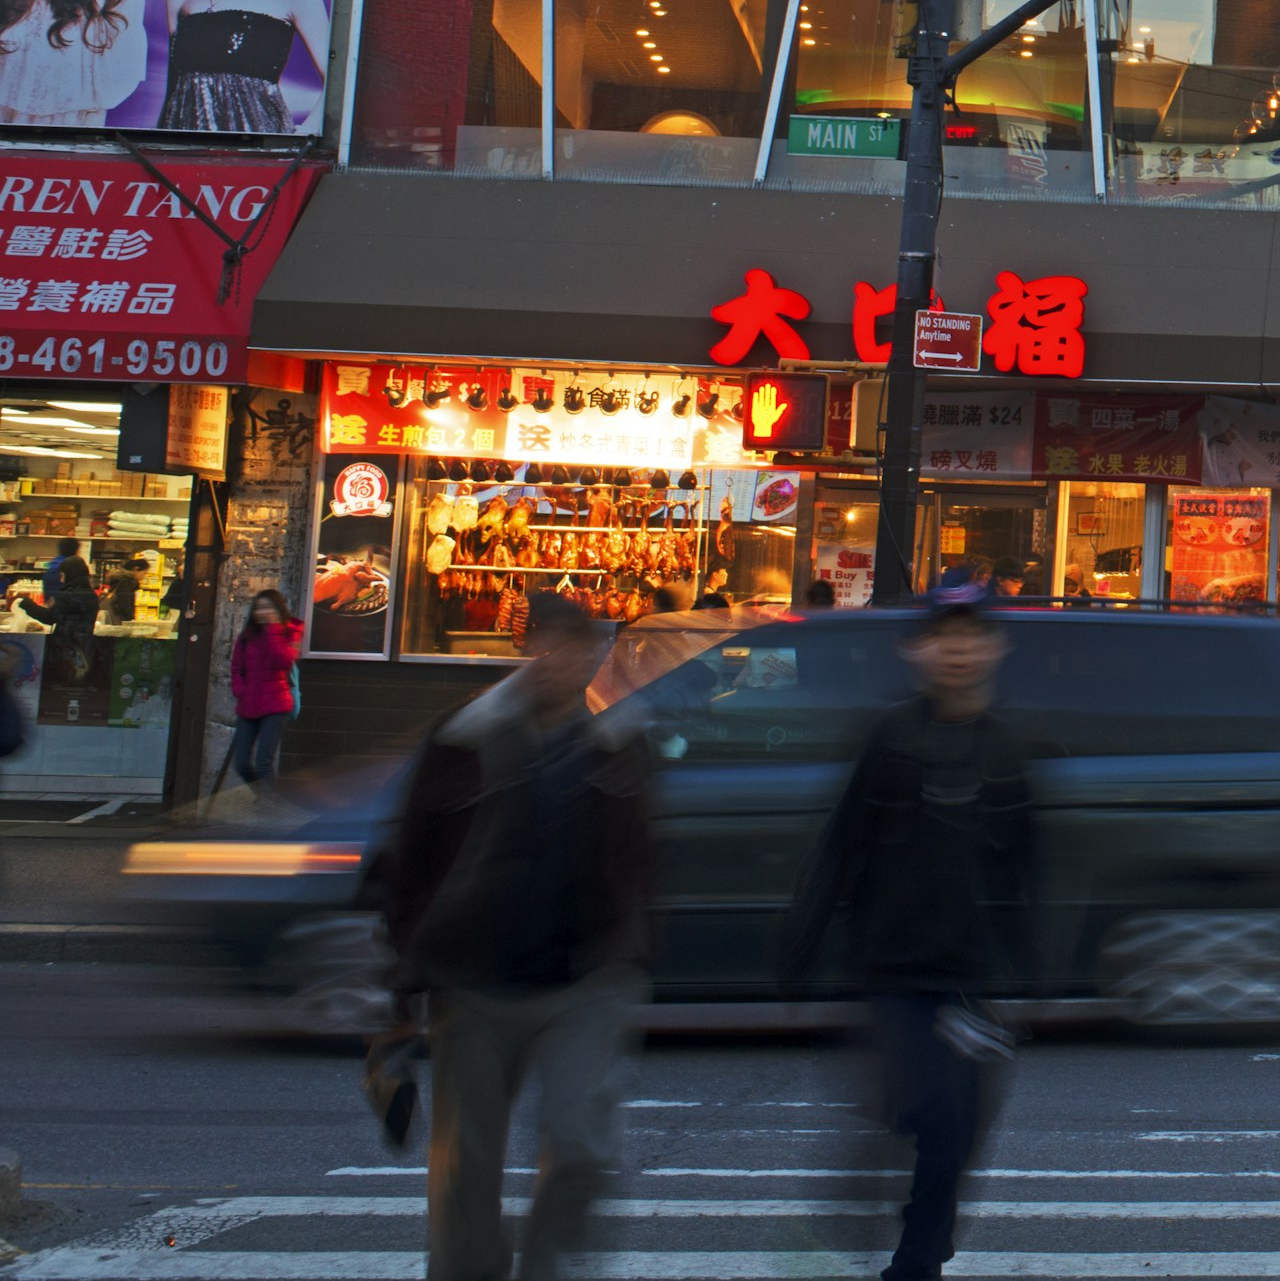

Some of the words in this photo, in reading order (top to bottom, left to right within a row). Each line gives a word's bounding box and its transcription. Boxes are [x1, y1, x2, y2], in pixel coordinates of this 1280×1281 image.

[807, 123, 857, 150] MAIN
[869, 125, 884, 142] ST
[124, 182, 271, 222] TANG
[920, 317, 932, 329] NO
[933, 318, 971, 331] STANDING
[919, 329, 952, 343] Anytime
